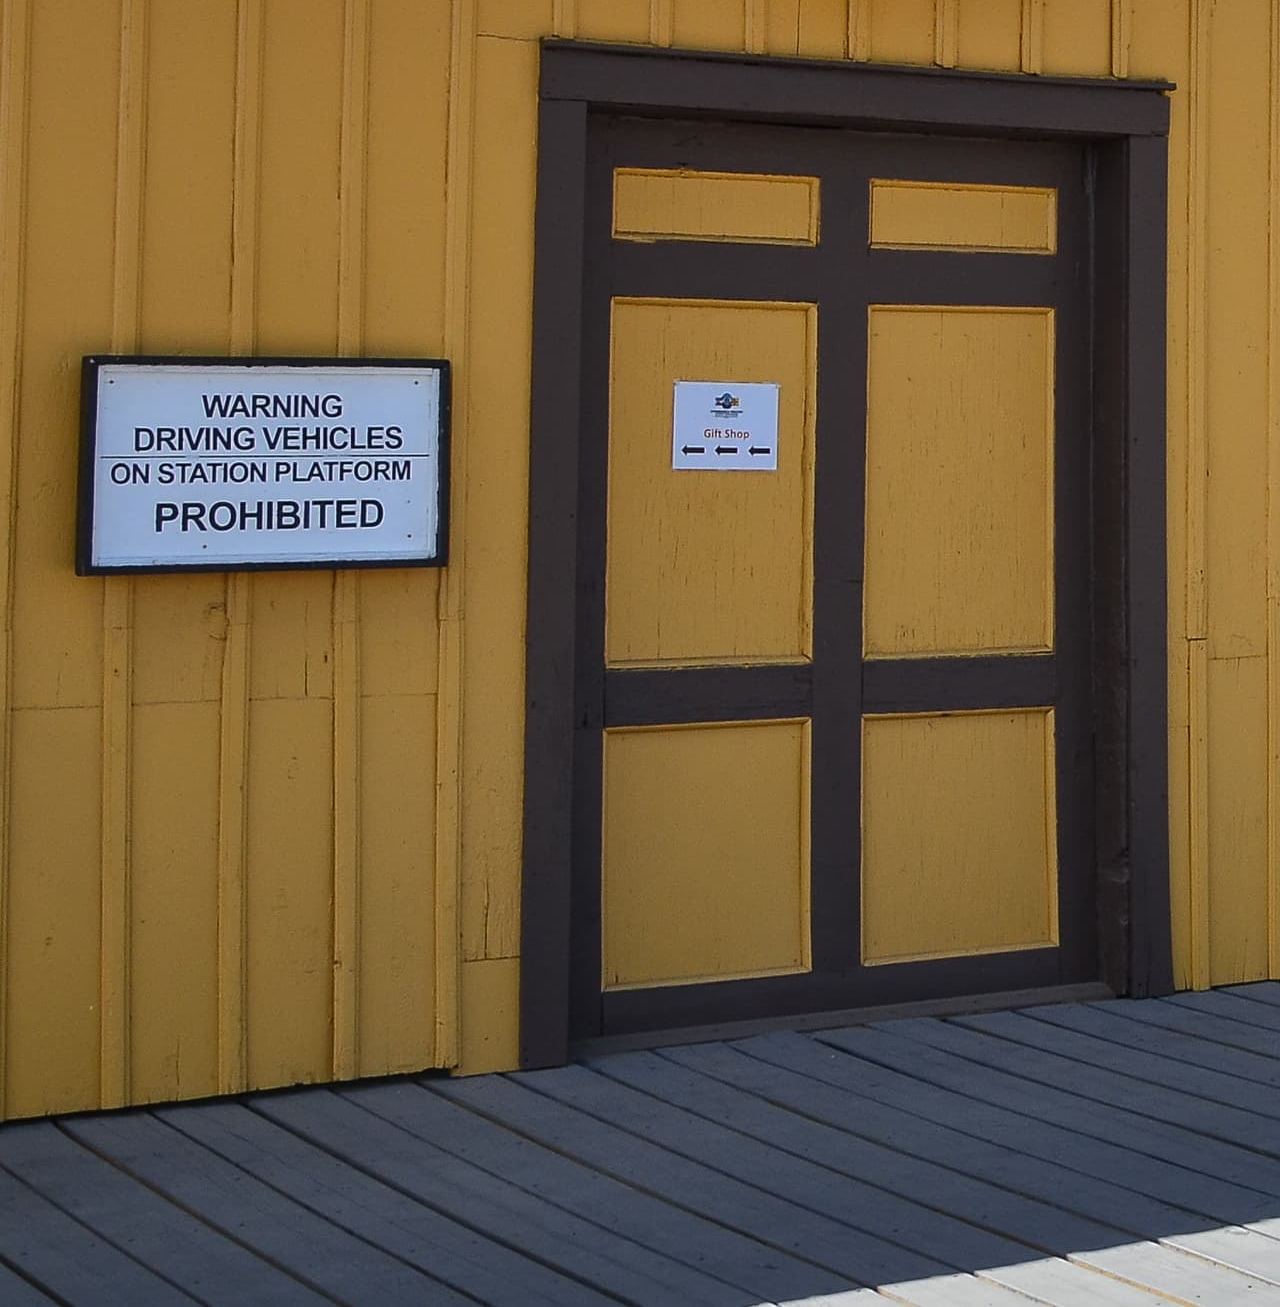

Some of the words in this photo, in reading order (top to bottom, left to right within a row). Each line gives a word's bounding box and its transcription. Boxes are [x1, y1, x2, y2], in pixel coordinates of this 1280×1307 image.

[202, 395, 343, 418] WARNING
[134, 427, 255, 452] DRIVING
[262, 426, 403, 451] VEHICLES
[704, 428, 721, 438] Gift
[724, 428, 750, 441] Shop
[111, 463, 150, 484] ON
[158, 462, 267, 484] STATION
[274, 460, 411, 482] PLATFORM
[155, 499, 385, 533] PROHIBITED
